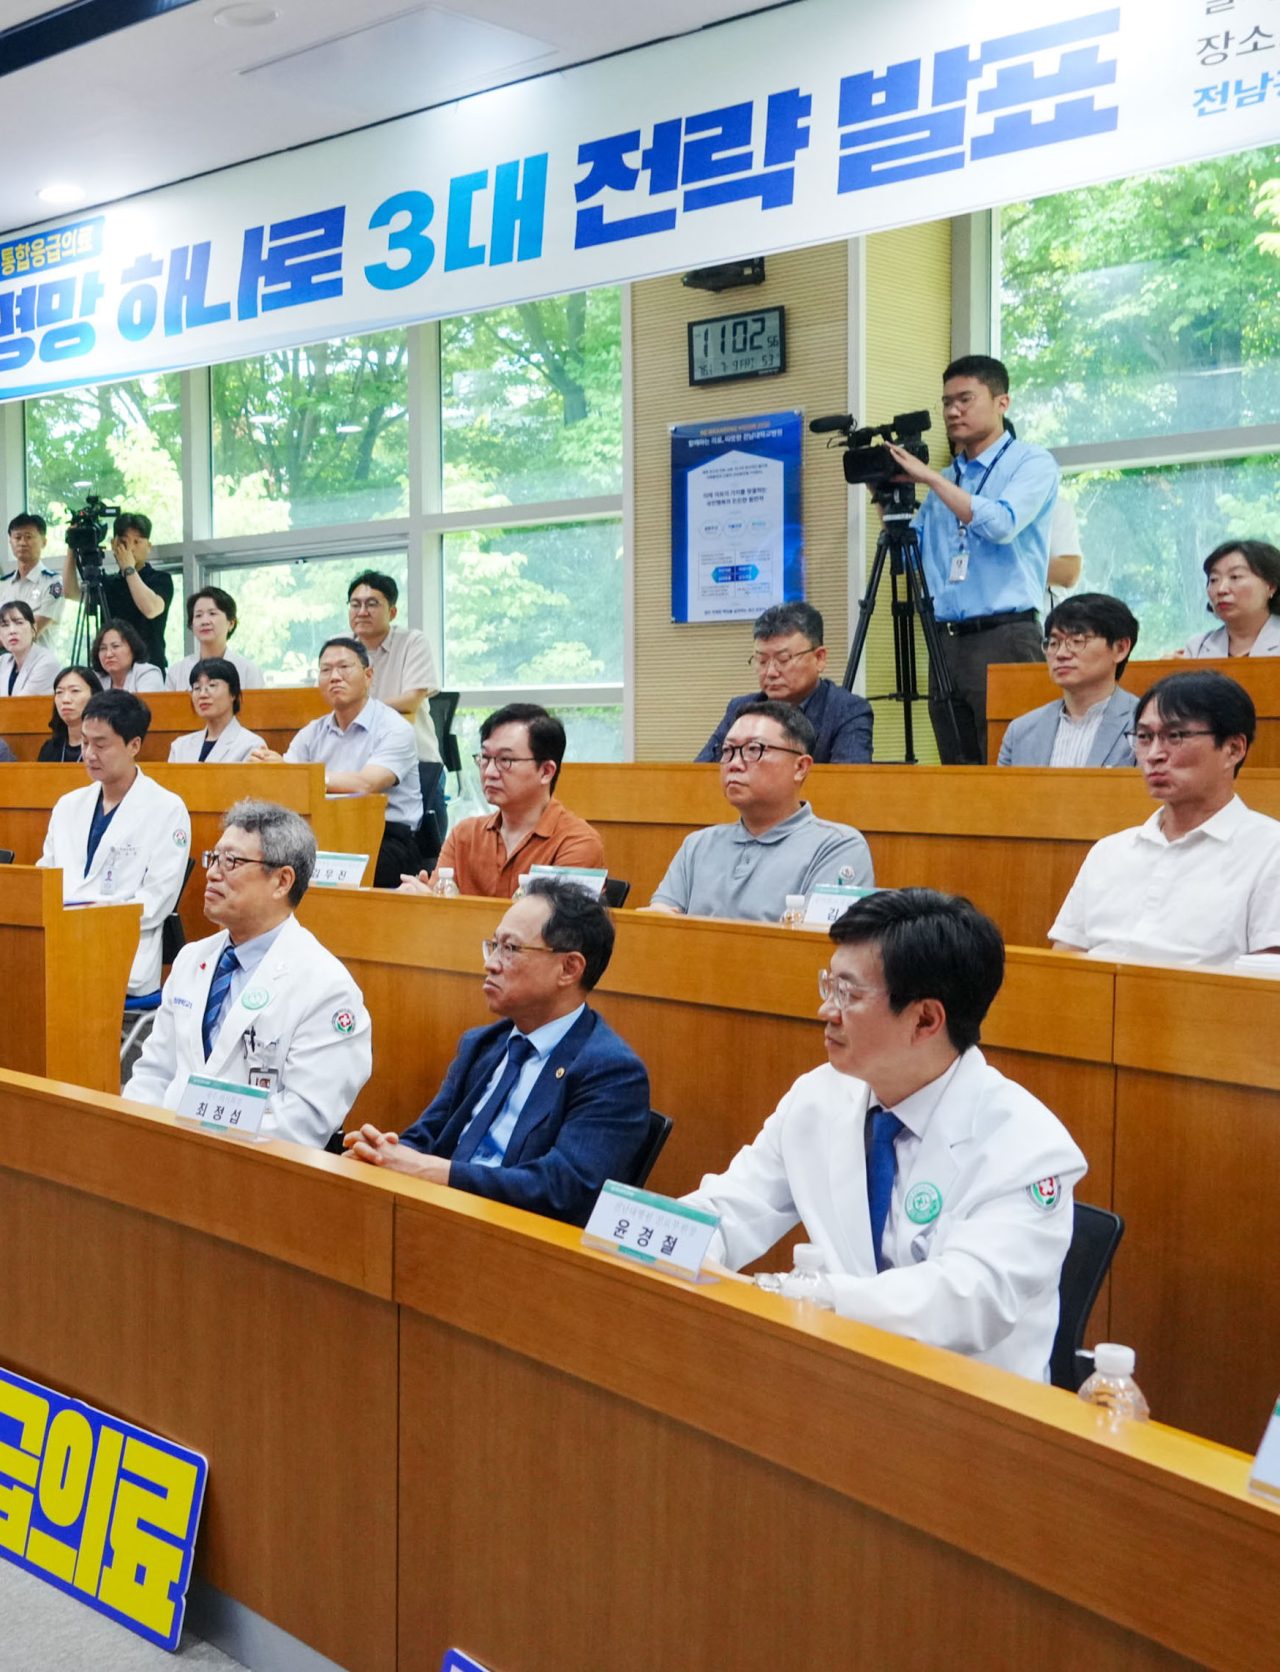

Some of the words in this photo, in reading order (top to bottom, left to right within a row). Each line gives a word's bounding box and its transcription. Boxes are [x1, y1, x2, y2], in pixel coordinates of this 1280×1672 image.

[117, 205, 346, 342] 해나로
[362, 152, 549, 290] 3대
[573, 87, 812, 250] 전략
[836, 8, 1122, 195] 발표
[1, 225, 95, 276] 통합응급의료
[195, 1101, 242, 1125] 최정섭
[613, 1218, 678, 1256] 윤경철
